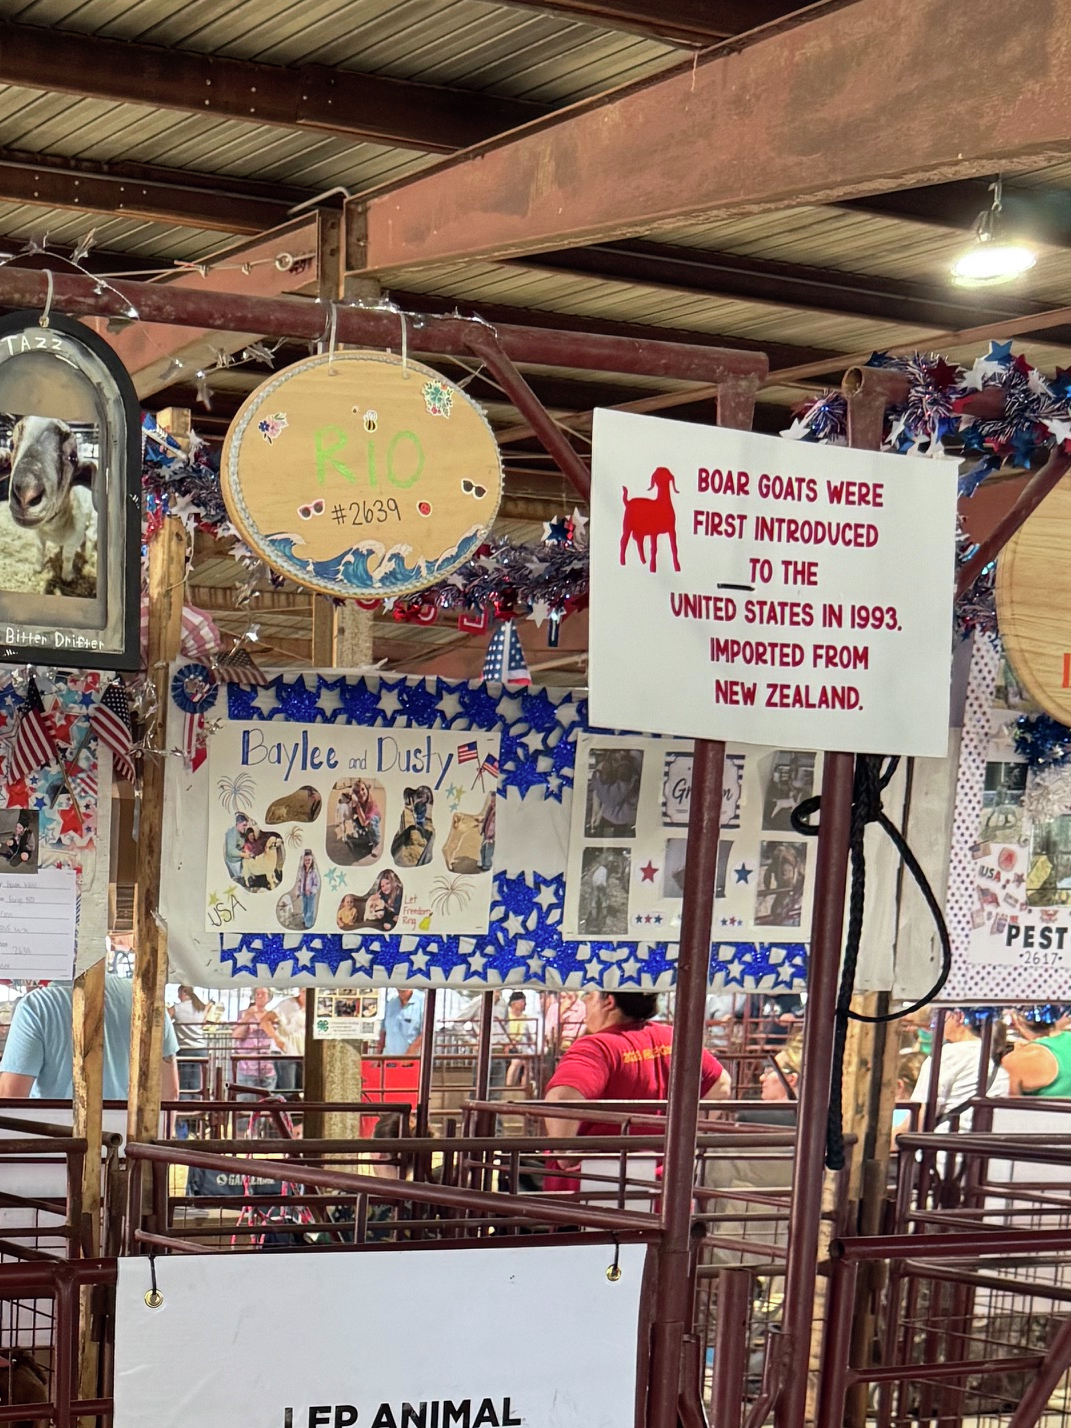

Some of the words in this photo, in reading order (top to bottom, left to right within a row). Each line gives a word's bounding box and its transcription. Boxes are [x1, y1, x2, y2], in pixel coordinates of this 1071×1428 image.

[0, 335, 63, 356] TAZZ
[314, 424, 425, 489] RIO
[697, 468, 750, 496] BOAR
[758, 474, 818, 503] GOATS
[826, 480, 884, 507] WERE
[331, 497, 402, 526] #2639
[693, 510, 748, 539] FIRST
[754, 516, 879, 548] INTRODUCED
[749, 557, 773, 584] TO
[781, 560, 819, 586] THE
[670, 592, 737, 622] UNITED
[744, 599, 814, 627] STATES
[822, 603, 843, 629] IN
[850, 604, 903, 632] 1993.
[5, 627, 47, 645] Bitter
[54, 631, 105, 650] Drifter
[710, 637, 805, 668] IMPORTED
[813, 643, 870, 670] FROM
[715, 679, 757, 706] NEW
[765, 683, 864, 711] ZEALAND.
[241, 728, 339, 782] Baylee
[348, 749, 367, 770] and
[377, 735, 454, 791] Dusty
[979, 865, 1001, 882] USA
[207, 894, 247, 927] USA
[404, 895, 417, 904] Let
[1006, 924, 1068, 950] PEST
[1024, 950, 1059, 966] 2617
